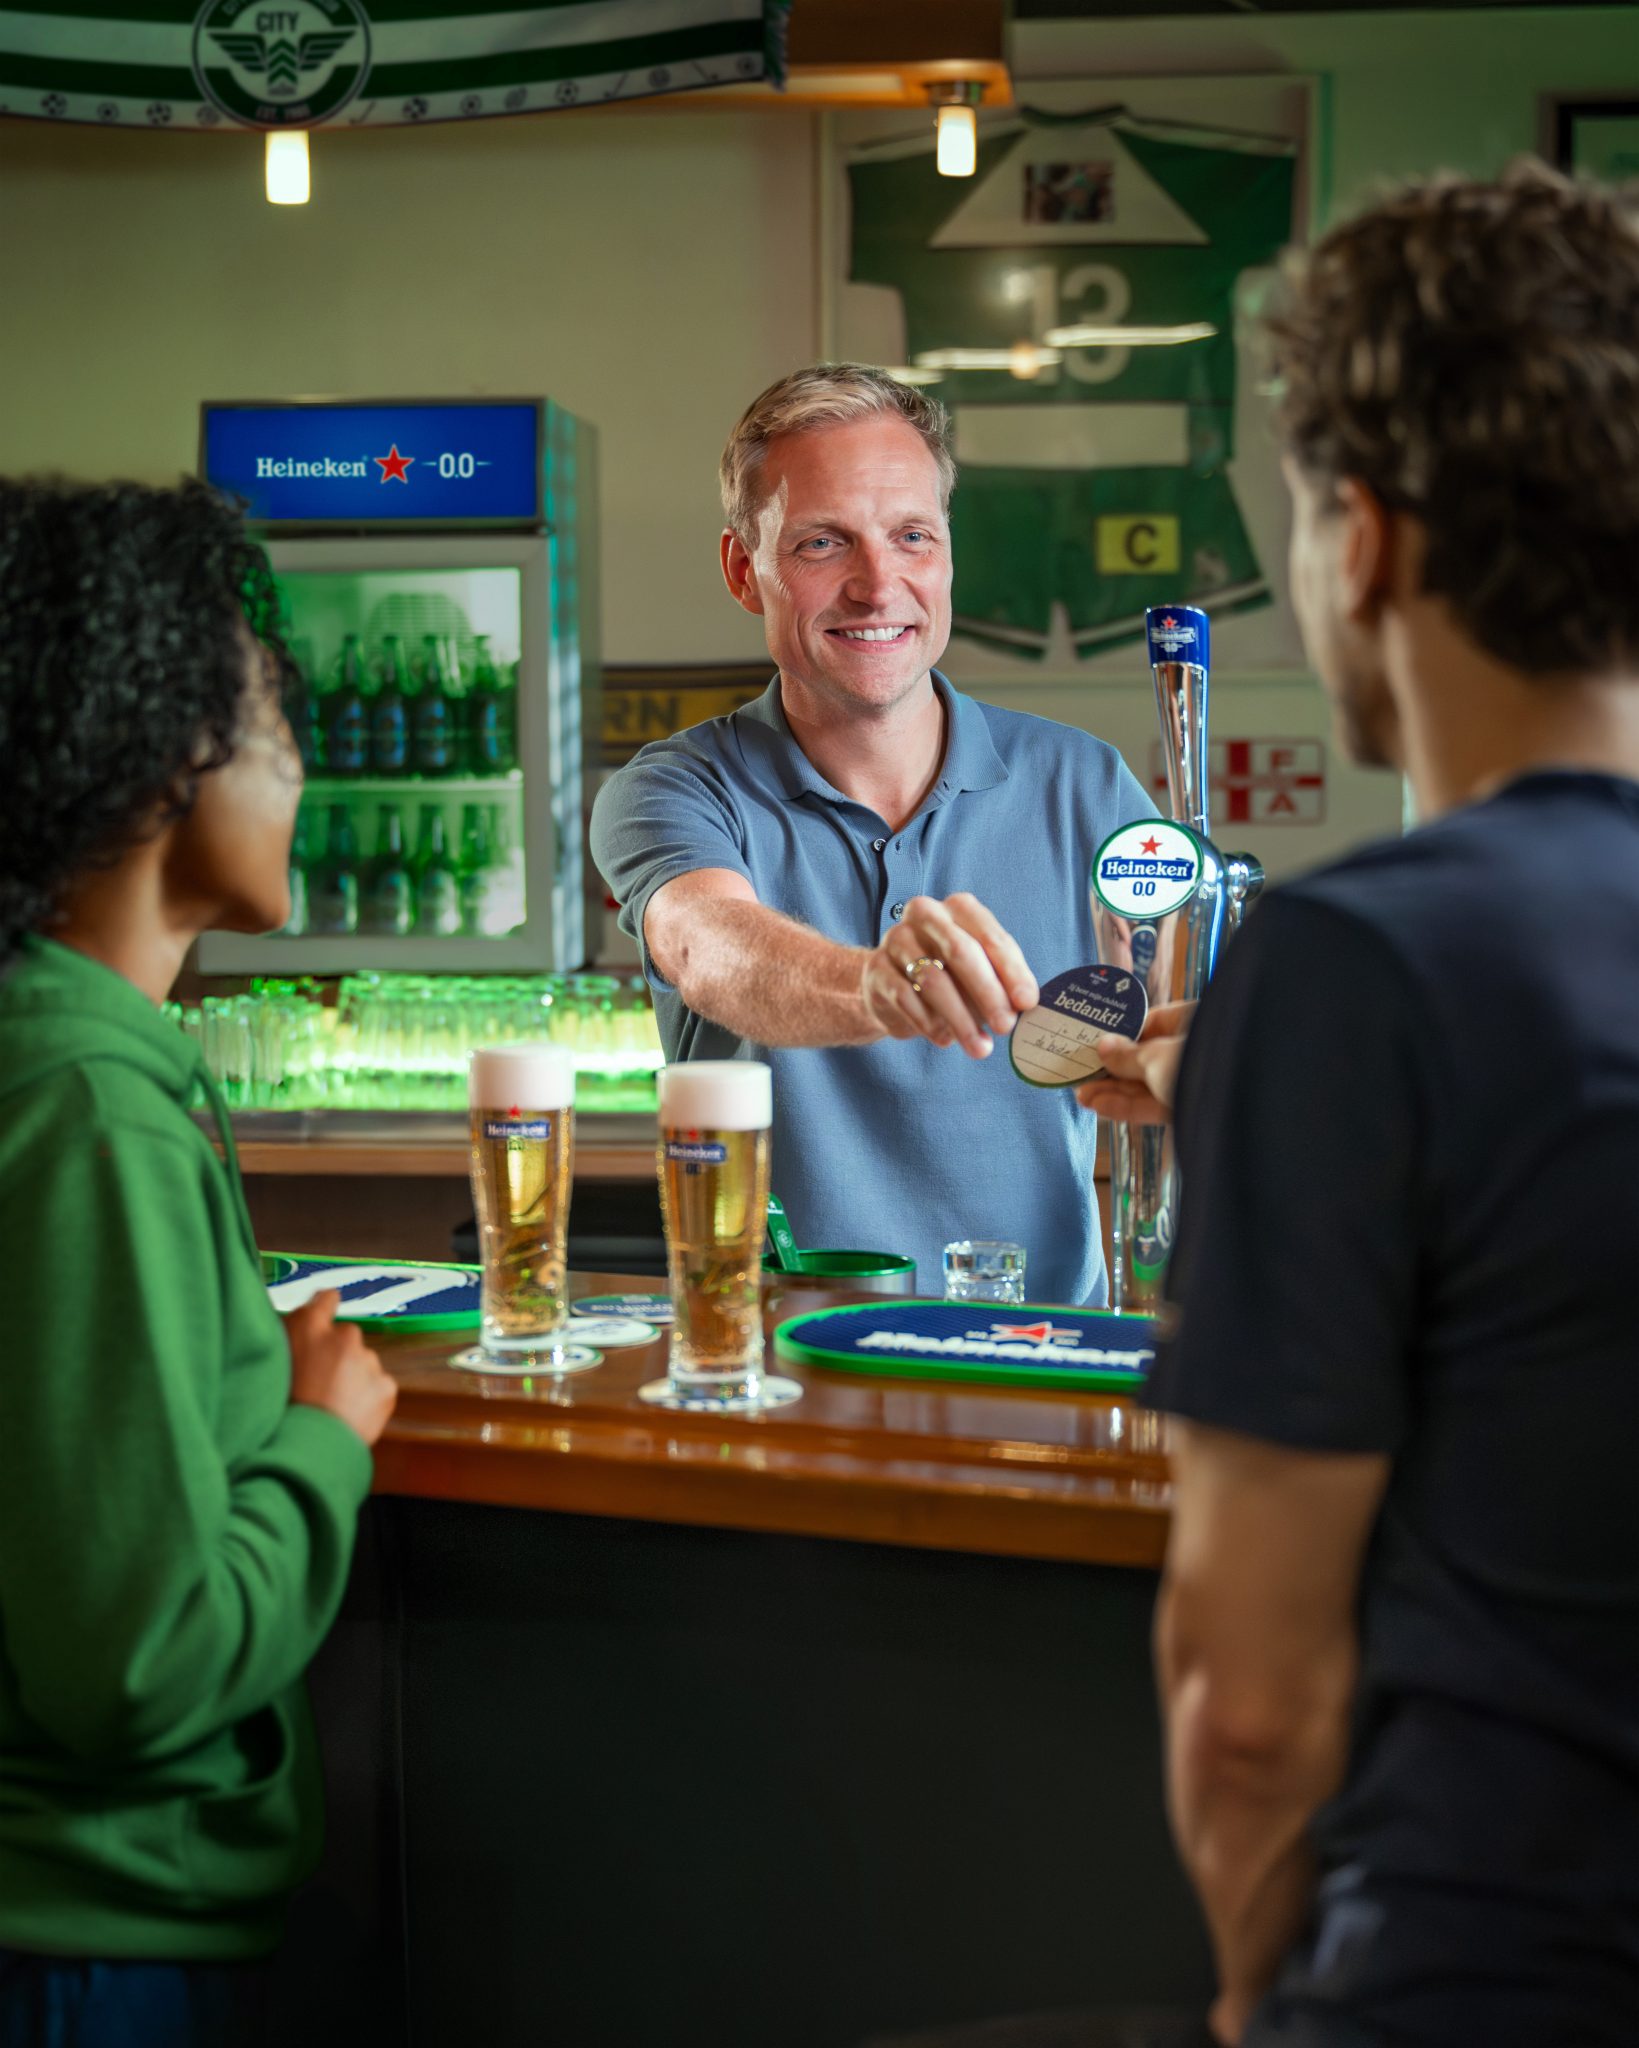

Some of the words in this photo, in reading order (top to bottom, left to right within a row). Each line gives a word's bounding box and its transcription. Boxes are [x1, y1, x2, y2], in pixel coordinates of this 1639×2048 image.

[255, 12, 299, 32] CITY
[1016, 263, 1132, 386] 13
[256, 457, 367, 478] Heineken
[1124, 522, 1158, 568] C
[1106, 861, 1188, 877] Heineken
[1132, 881, 1156, 897] 0.0
[1053, 991, 1125, 1028] bedankt!
